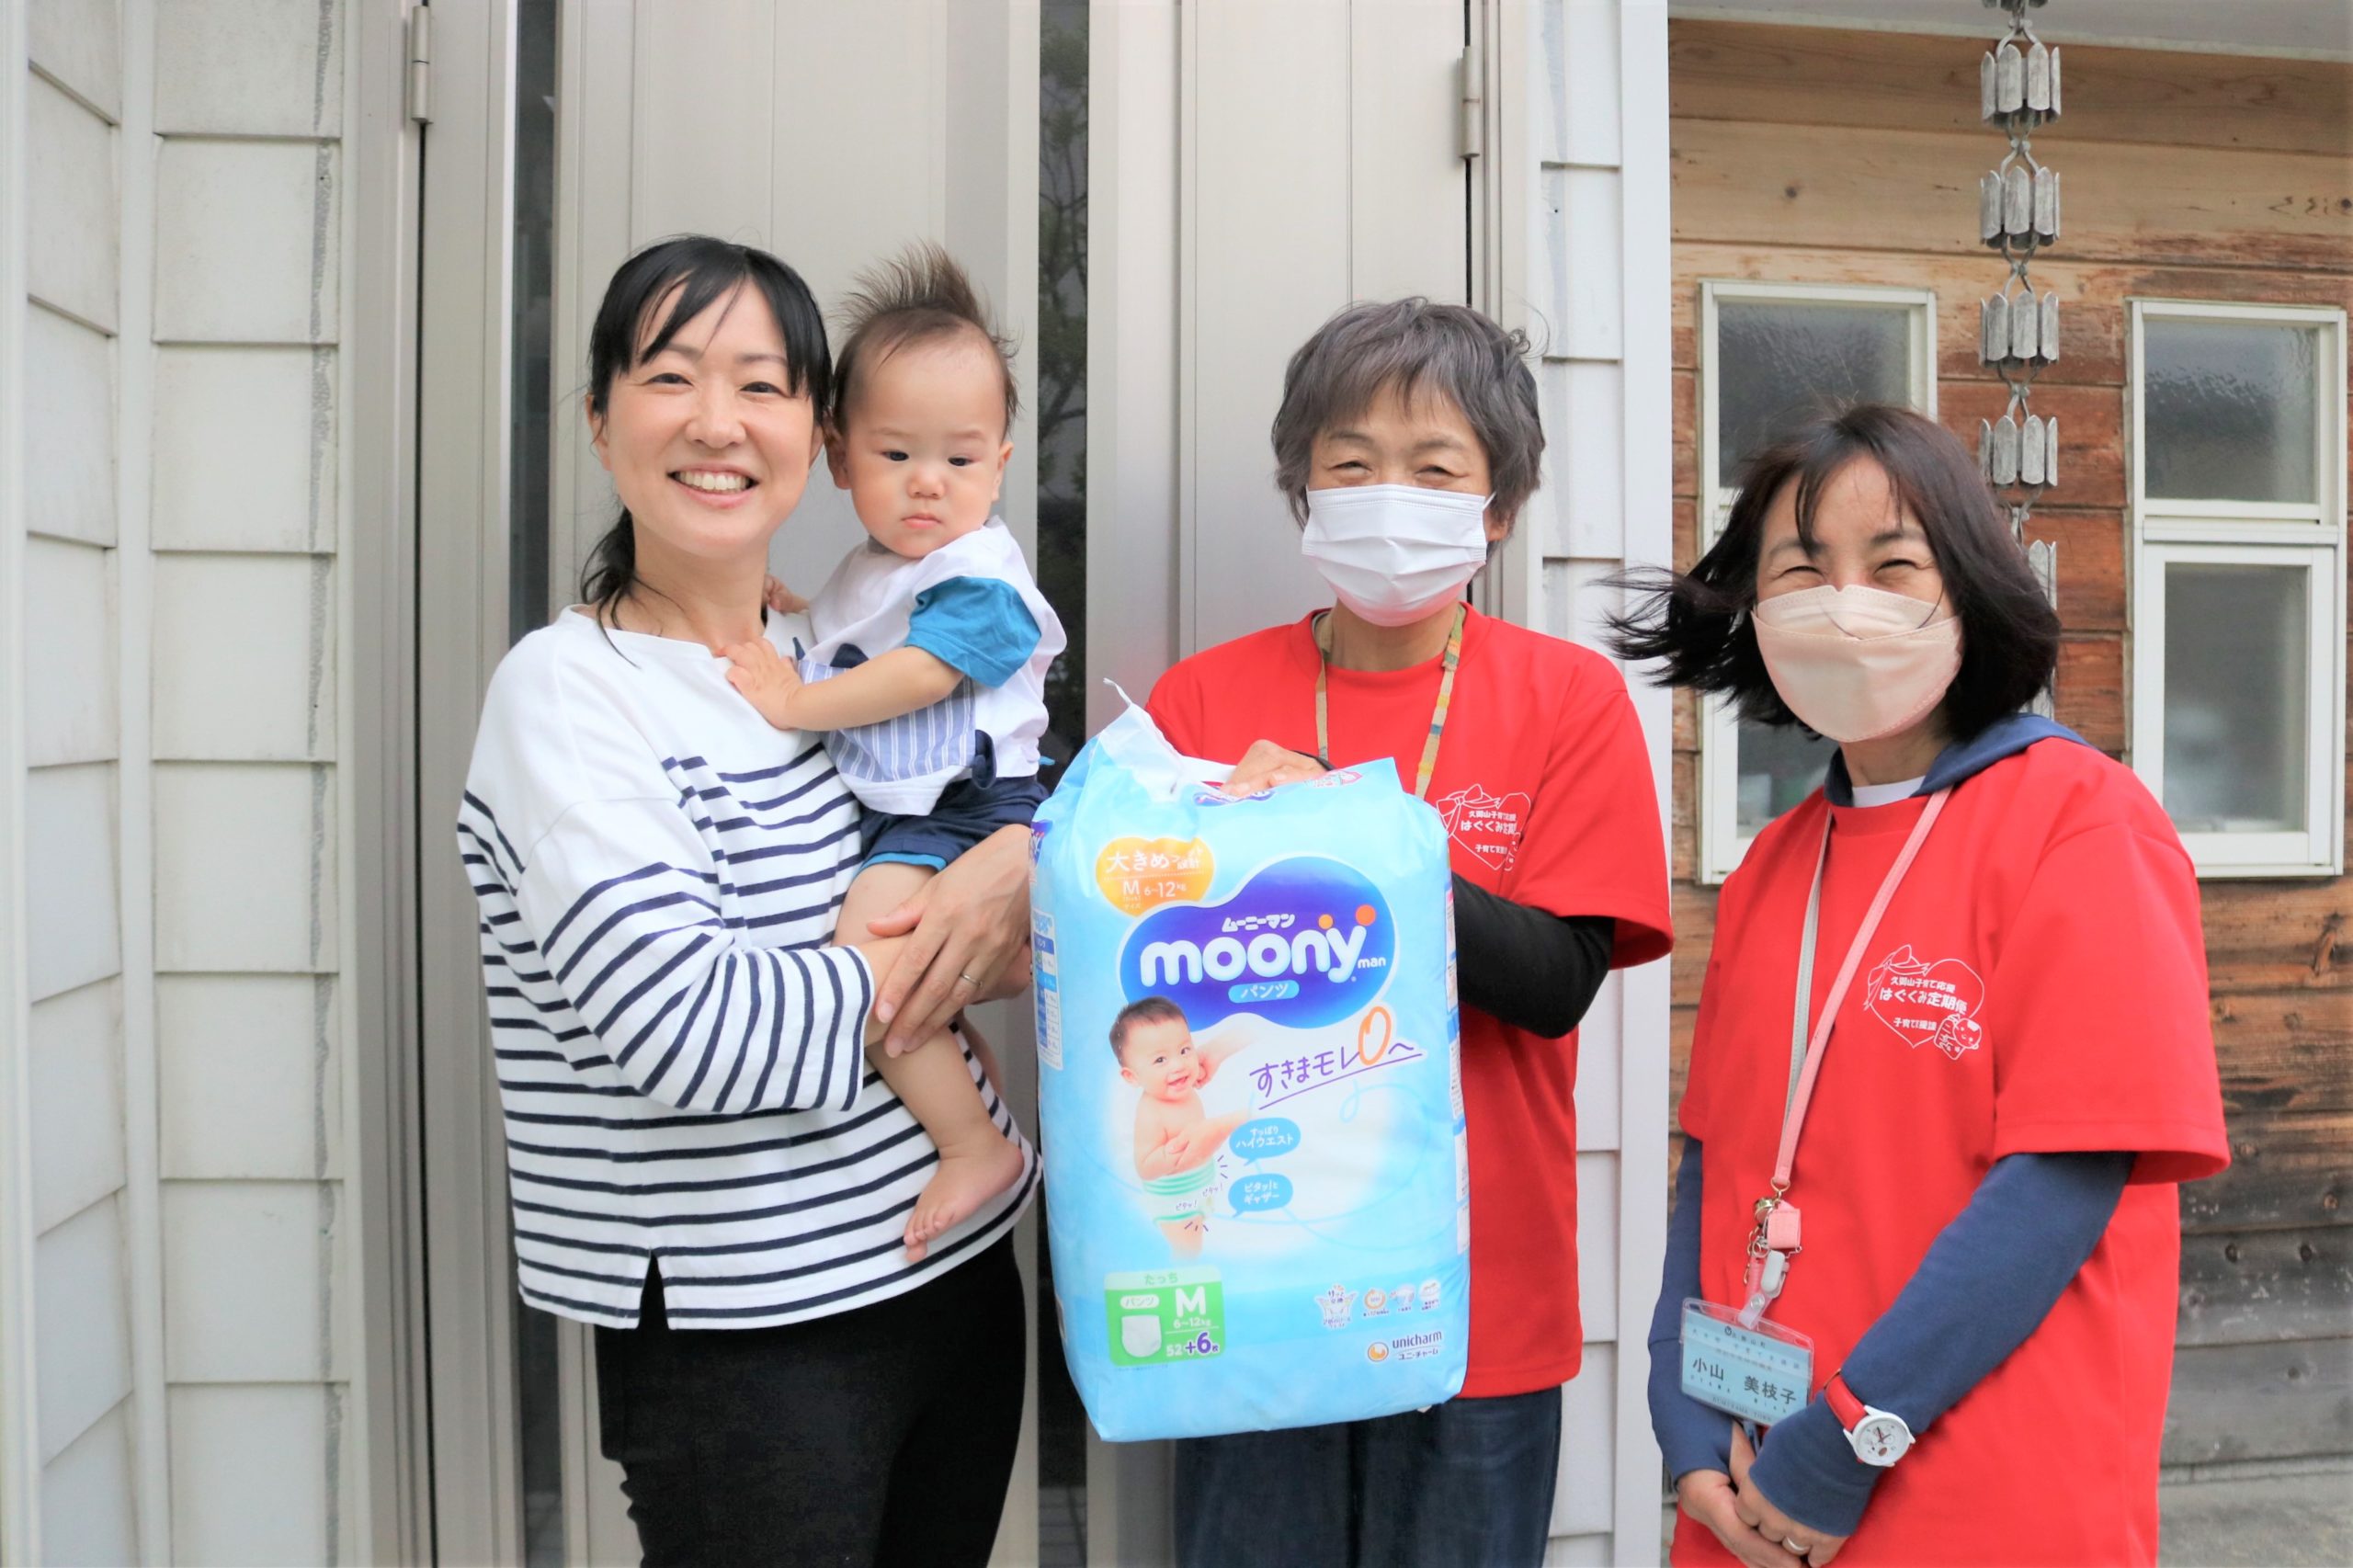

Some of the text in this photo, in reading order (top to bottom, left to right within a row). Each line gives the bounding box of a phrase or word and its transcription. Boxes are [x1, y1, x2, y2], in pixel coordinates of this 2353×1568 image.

[1106, 850, 1169, 873] 大きめ
[1123, 881, 1140, 895] M
[1222, 913, 1296, 933] ムーニーマン
[1140, 925, 1386, 987] moony man
[1241, 983, 1290, 998] パンツ
[1880, 987, 1967, 1015] はぐくみ定期便
[1235, 1133, 1293, 1149] ハイウエスト
[1244, 1191, 1279, 1205] ギャザー
[1144, 1272, 1178, 1286] たっち
[1125, 1297, 1154, 1307] パンツ
[1176, 1286, 1206, 1318] M
[1392, 1330, 1442, 1349] unicharm
[1693, 1358, 1724, 1381] 小山
[1744, 1376, 1796, 1404] 美枝子
